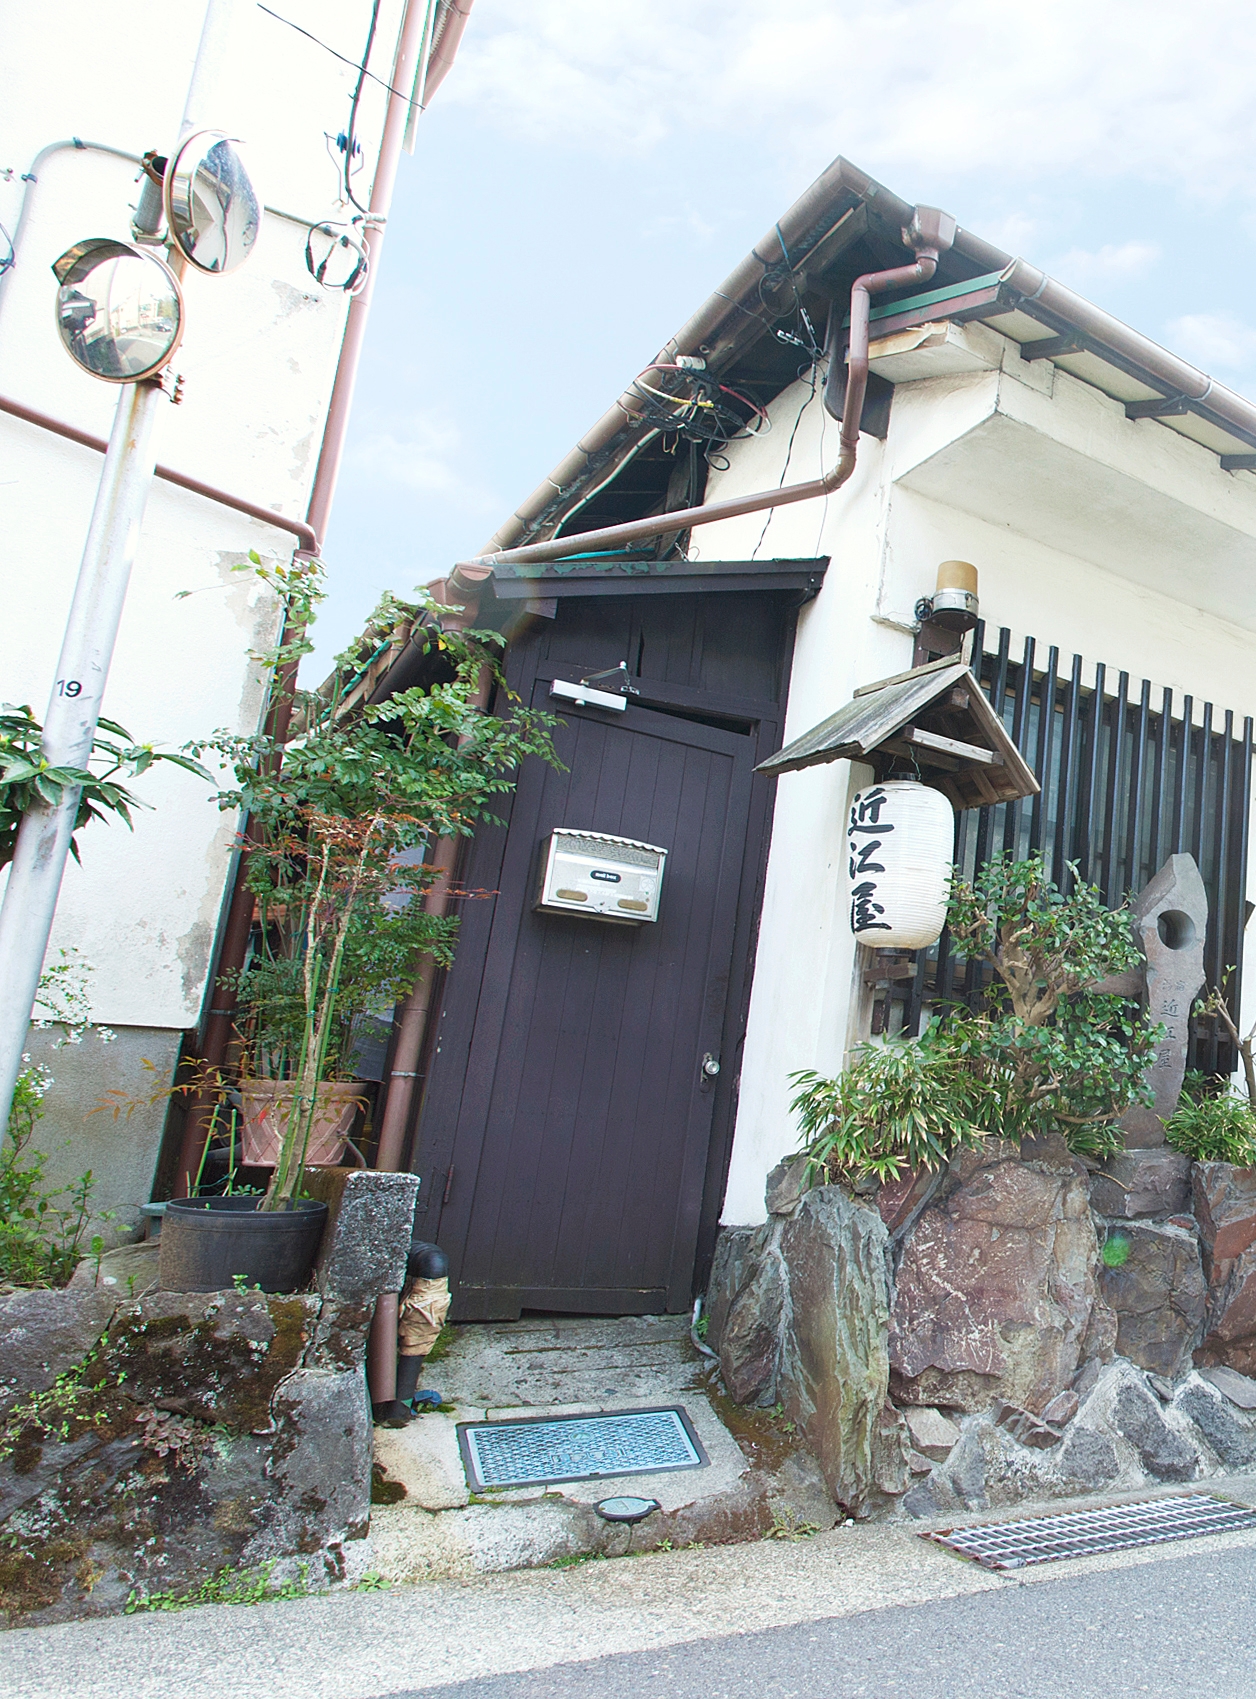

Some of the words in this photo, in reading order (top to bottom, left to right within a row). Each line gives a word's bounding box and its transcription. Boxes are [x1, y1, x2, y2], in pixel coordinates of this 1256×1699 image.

[57, 679, 83, 698] 19
[847, 787, 895, 934] 近江屋
